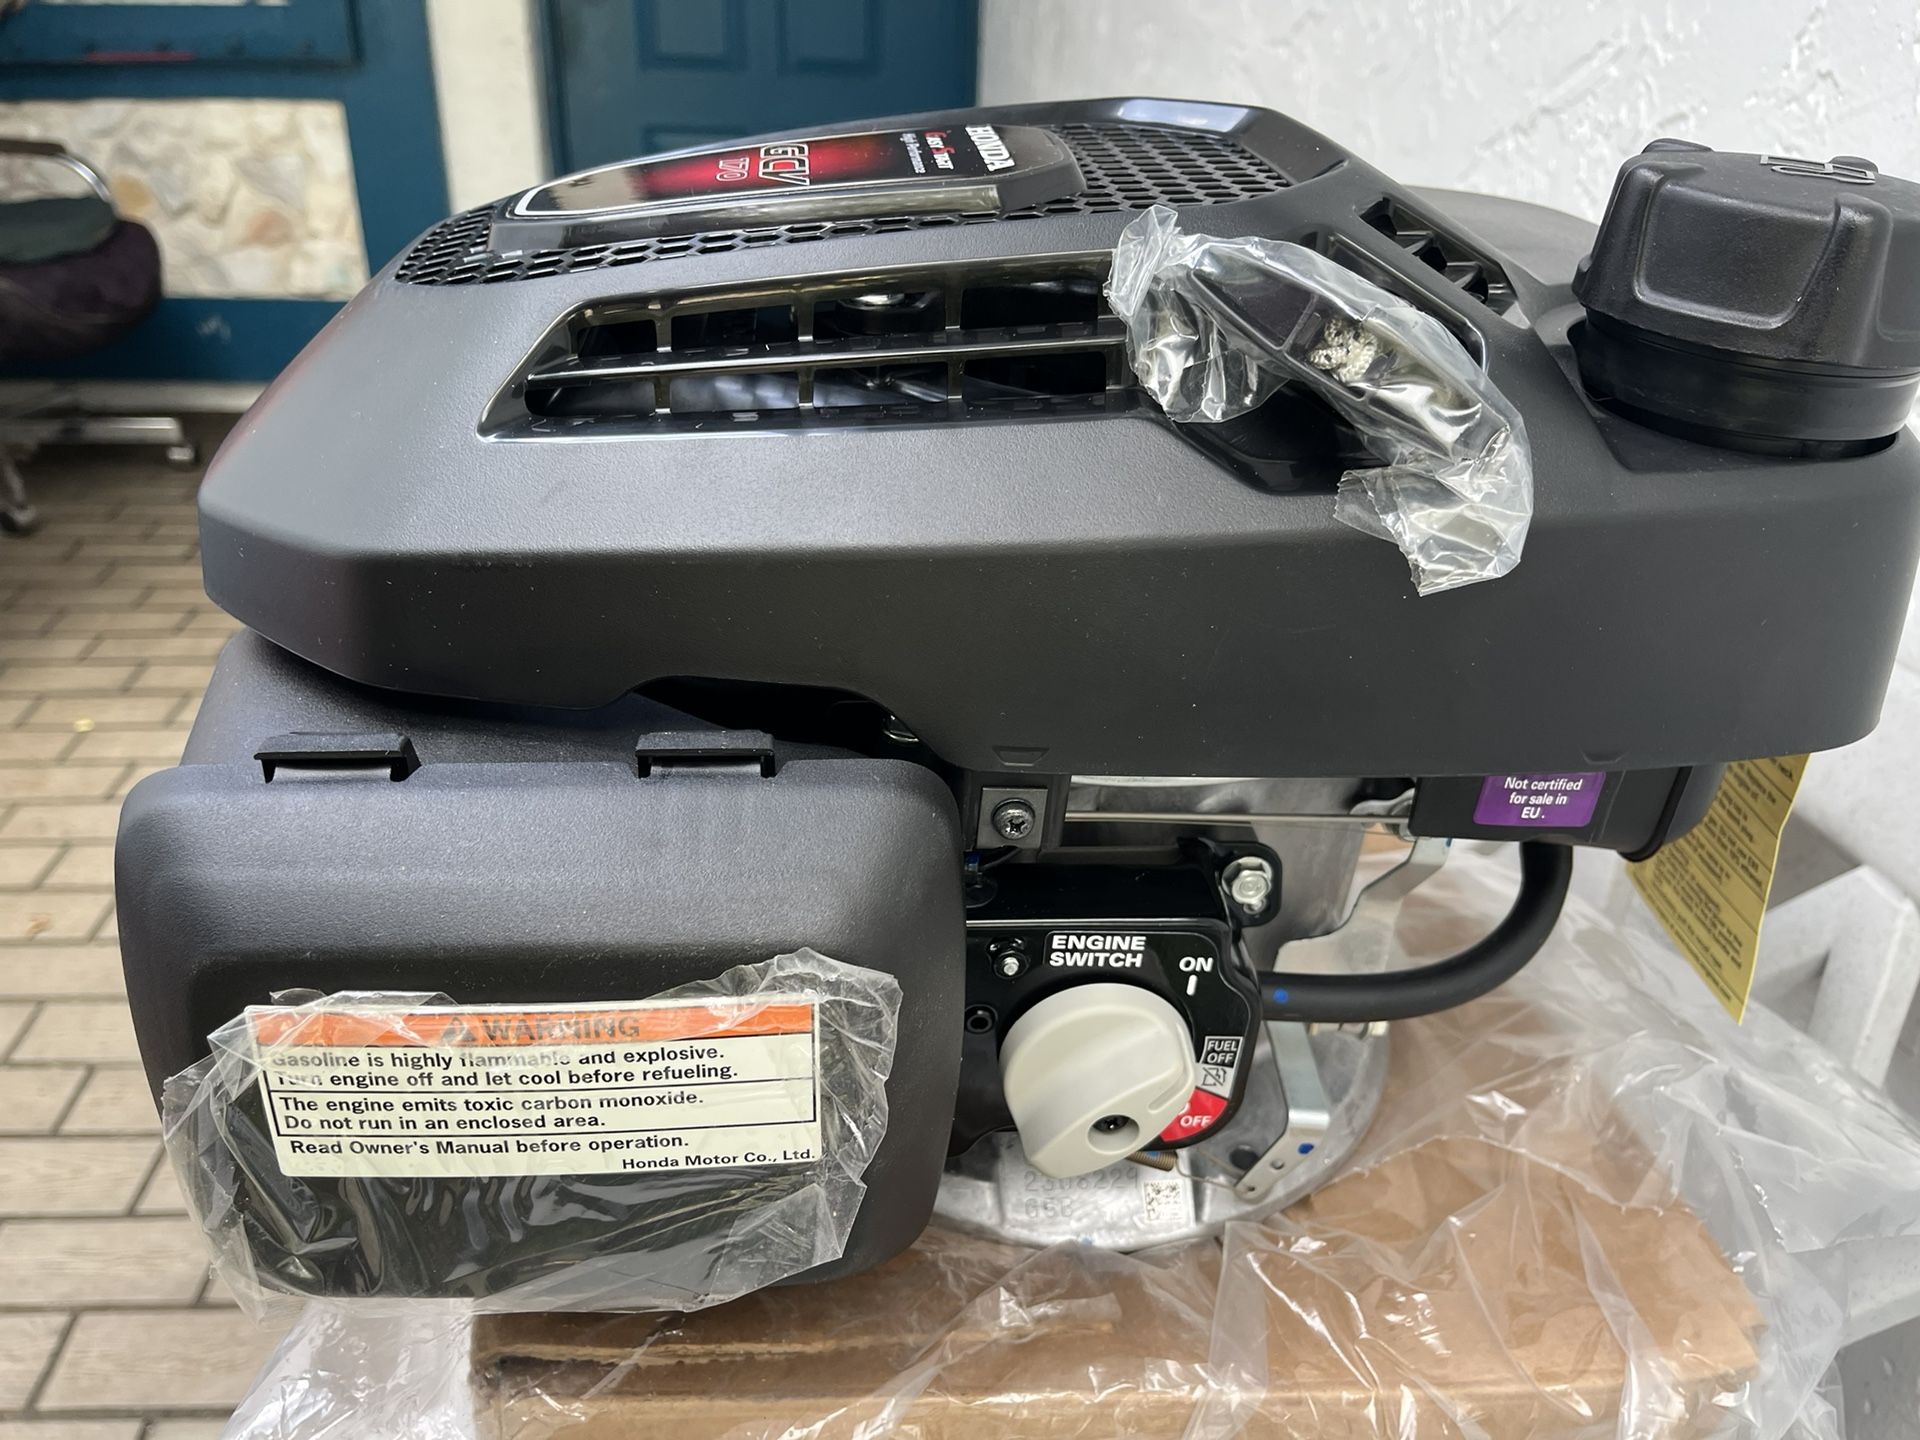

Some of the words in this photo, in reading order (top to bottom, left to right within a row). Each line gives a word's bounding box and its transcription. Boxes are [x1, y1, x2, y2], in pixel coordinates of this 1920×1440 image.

[965, 124, 1015, 172] HONDA
[716, 156, 750, 181] 170
[759, 143, 810, 186] GCV
[931, 147, 955, 170] START
[1504, 776, 1528, 790] Not
[1530, 778, 1583, 791] certified
[1508, 792, 1527, 804] for
[1528, 793, 1554, 805] sale
[1555, 793, 1568, 805] in
[1051, 935, 1147, 951] ENGINE
[1049, 951, 1143, 967] SWITCH
[1178, 956, 1213, 972] ON
[481, 1015, 640, 1042] WARNING
[1207, 1040, 1238, 1052] FUEL
[272, 1051, 360, 1067] Gasoline
[367, 1053, 385, 1067] is
[391, 1053, 453, 1071] highly
[578, 1051, 616, 1065] and
[624, 1046, 725, 1065] explosive.
[1206, 1052, 1234, 1064] OFF
[330, 1072, 399, 1089] engine
[406, 1072, 434, 1086] off
[441, 1072, 478, 1087] and
[485, 1071, 512, 1086] let
[518, 1070, 561, 1085] cool
[568, 1069, 635, 1084] before
[642, 1064, 738, 1080] refueling.
[279, 1097, 319, 1111] The
[326, 1098, 395, 1114] engine
[402, 1097, 457, 1112] emits
[464, 1097, 514, 1112] toxic
[521, 1096, 592, 1110] carbon
[599, 1091, 704, 1108] monoxide.
[284, 1115, 313, 1129] Do
[320, 1116, 353, 1129] not
[358, 1118, 393, 1130] run
[399, 1116, 417, 1130] in
[424, 1118, 449, 1130] an
[456, 1114, 547, 1129] enclosed
[554, 1115, 606, 1128] area.
[1180, 1115, 1212, 1128] OFF
[290, 1140, 343, 1154] Read
[350, 1140, 430, 1154] Owner's
[435, 1140, 509, 1154] Manual
[516, 1139, 582, 1153] before
[588, 1134, 689, 1153] operation.
[622, 1157, 680, 1169] Honda
[685, 1155, 739, 1166] Motor
[744, 1151, 778, 1163] Co.,
[783, 1148, 816, 1161] Ltd.
